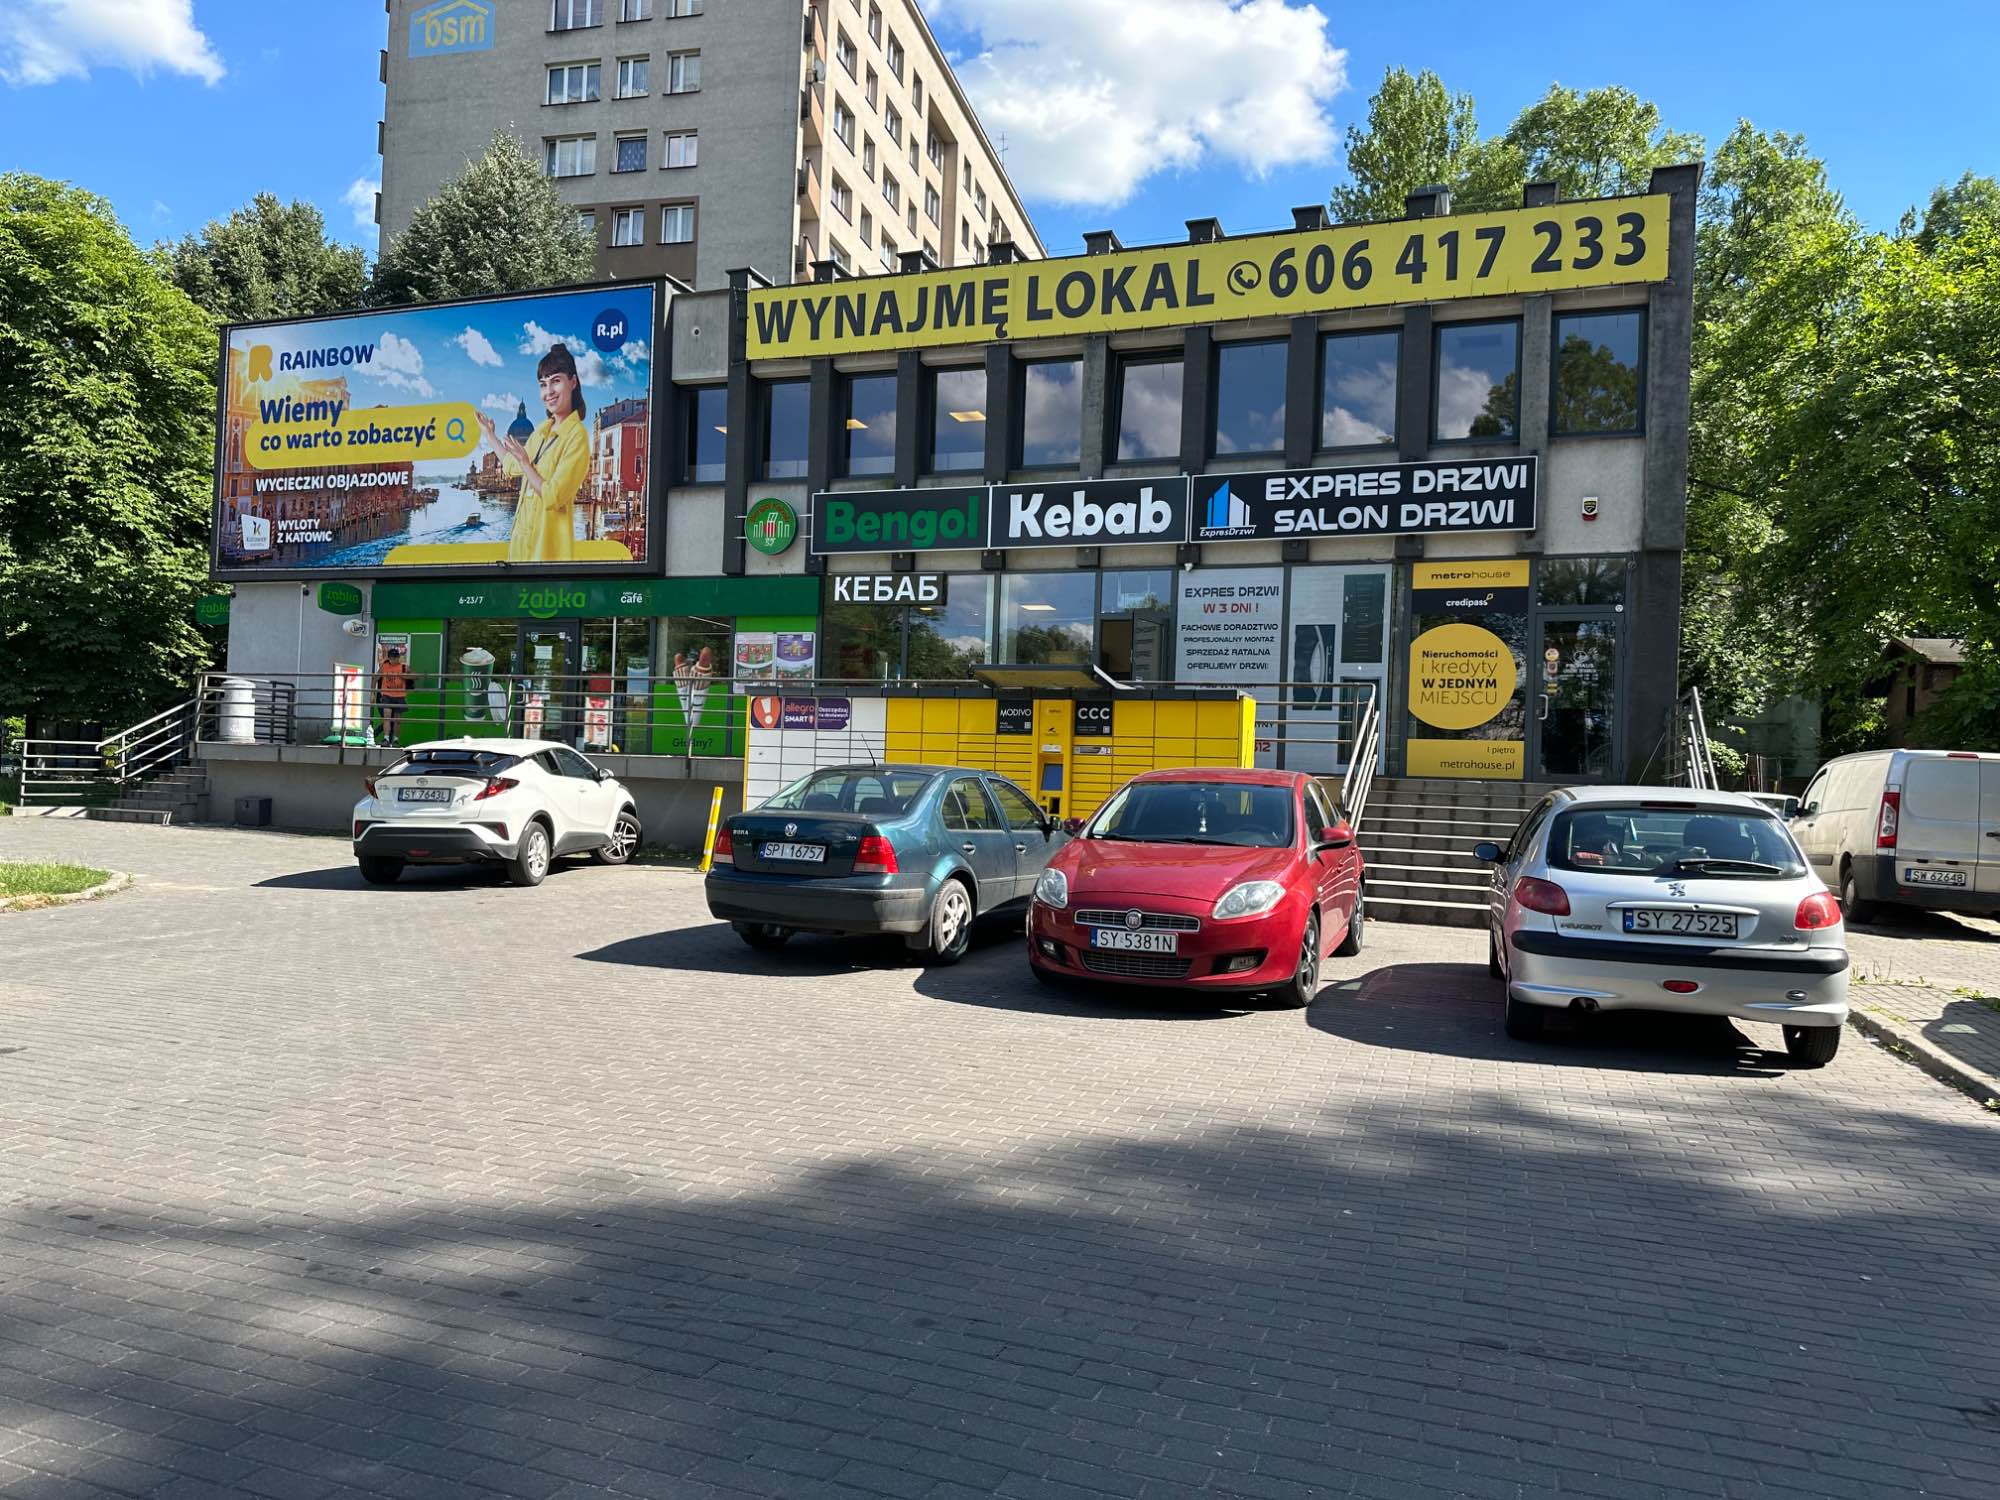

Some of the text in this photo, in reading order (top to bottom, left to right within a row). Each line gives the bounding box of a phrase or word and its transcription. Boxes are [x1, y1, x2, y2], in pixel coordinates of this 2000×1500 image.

[425, 14, 485, 48] bsm
[754, 211, 1647, 345] WYNAJMĘ LOKAL 606 417 233
[597, 320, 624, 339] R.pl
[280, 343, 375, 372] RAINBOW
[260, 396, 344, 427] Wiemy
[260, 417, 436, 451] co warto zobaczyć
[255, 470, 409, 492] WYCIECZKI OBJAZDOWE
[1265, 464, 1528, 501] EXPRES DRZWI
[826, 487, 1172, 549] Bengol Kebab
[1274, 499, 1515, 533] SALON DRZWI
[277, 518, 321, 531] WYLOTY
[276, 532, 284, 543] Z
[285, 530, 333, 543] KATOWIC
[1199, 526, 1256, 538] ExpresDrzwi
[1431, 570, 1511, 580] metrohouse
[834, 575, 939, 602] КЕБАБ
[1184, 585, 1280, 598] EXPRES DRZWI
[518, 588, 586, 609] żabka
[620, 592, 643, 604] café
[1445, 597, 1488, 608] credipass
[1203, 603, 1216, 614] W
[1219, 603, 1228, 613] 3
[1231, 602, 1252, 613] DNI
[1223, 623, 1279, 631] DORADZTWO
[1231, 648, 1271, 656] RATALNA
[1422, 650, 1498, 659] Nieruchomości
[1187, 662, 1238, 670] OFERUJEMY
[1431, 659, 1498, 678] kredyty
[1421, 678, 1497, 689] W JEDNYM
[1420, 690, 1498, 705] MIEJSCU
[785, 703, 815, 715] allegro
[1000, 708, 1032, 717] MODIVO
[1077, 707, 1110, 720] CCC
[1491, 746, 1516, 756] piętro
[1439, 760, 1516, 772] metrohouse.pl
[790, 845, 824, 860] 16757
[1637, 911, 1732, 933] SY 27525
[1124, 933, 1173, 951] 5381N
